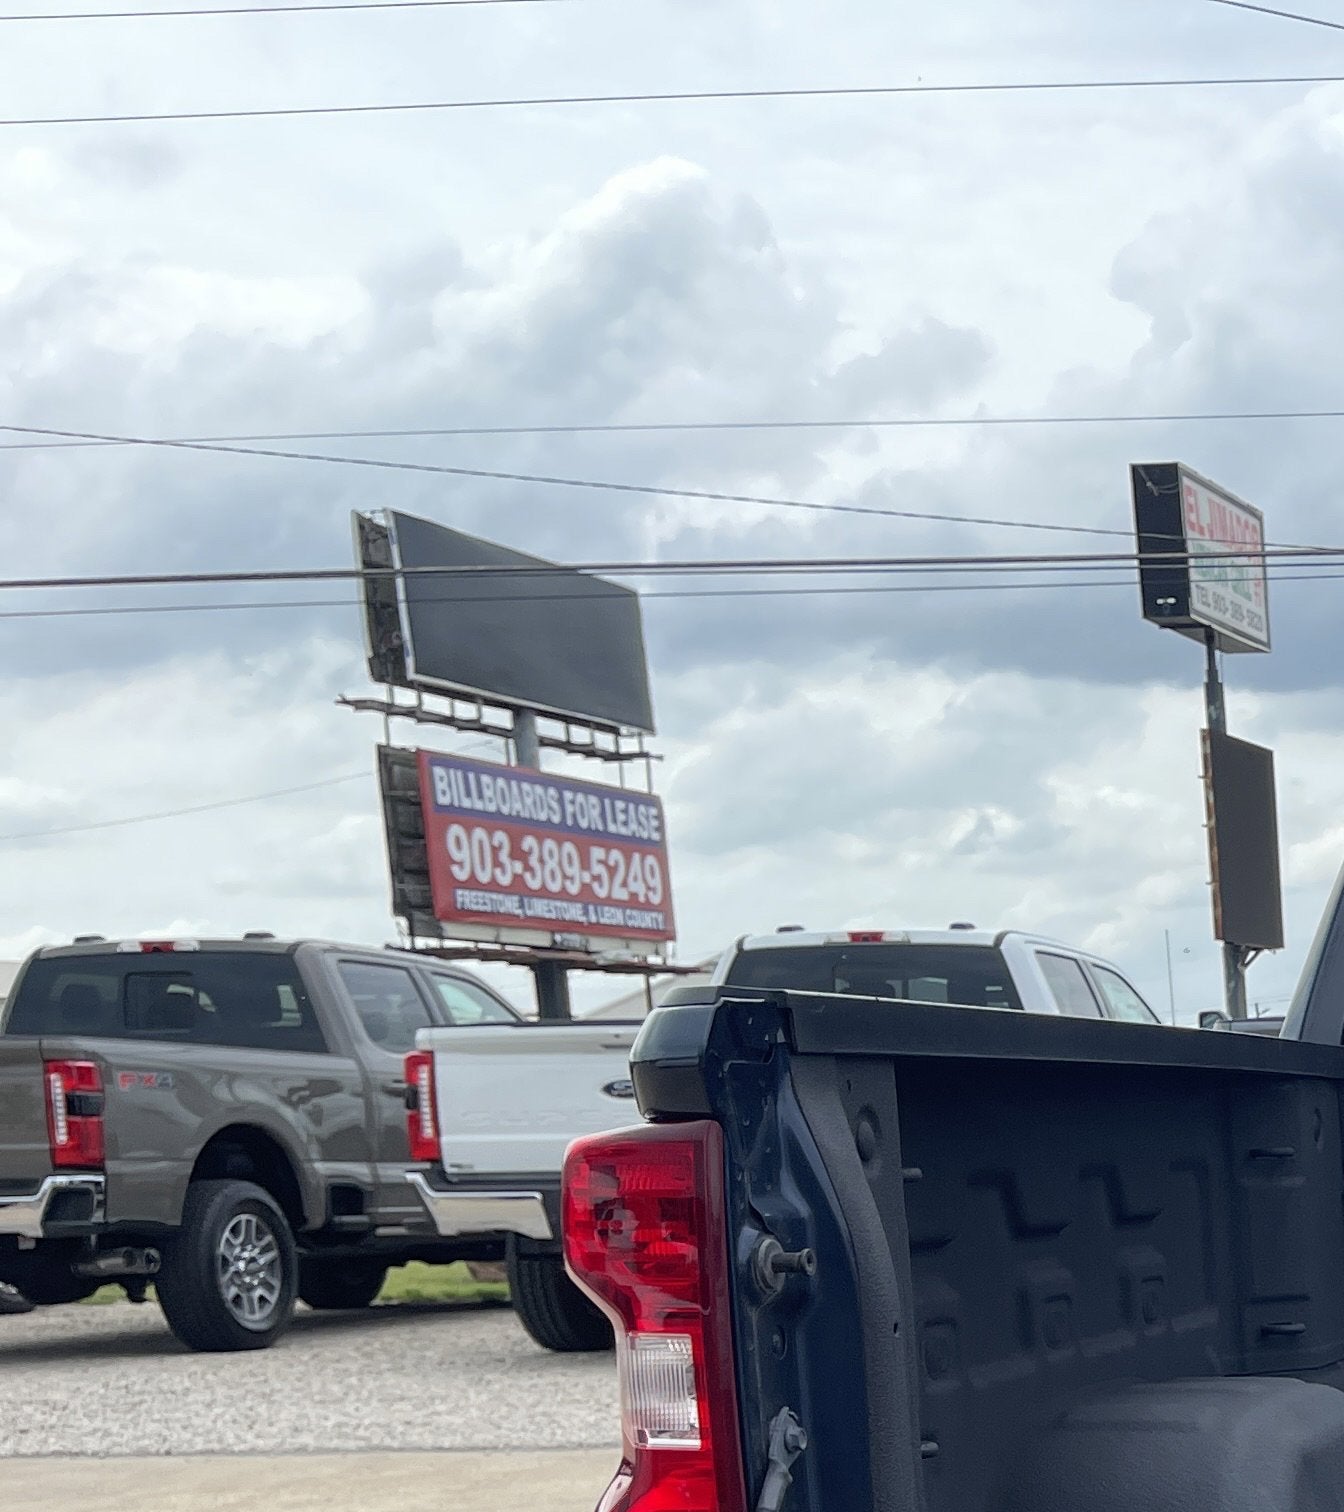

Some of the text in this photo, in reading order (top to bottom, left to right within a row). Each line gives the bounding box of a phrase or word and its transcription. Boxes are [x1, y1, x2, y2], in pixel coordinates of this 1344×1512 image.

[1184, 485, 1205, 536] EL
[432, 766, 661, 842] BILLBOARDS FOR LEASE
[446, 823, 663, 905] 903-389-5249
[456, 889, 523, 918] FREESTONE,
[525, 897, 588, 925] LIMESTONE,
[600, 907, 623, 926] LEON
